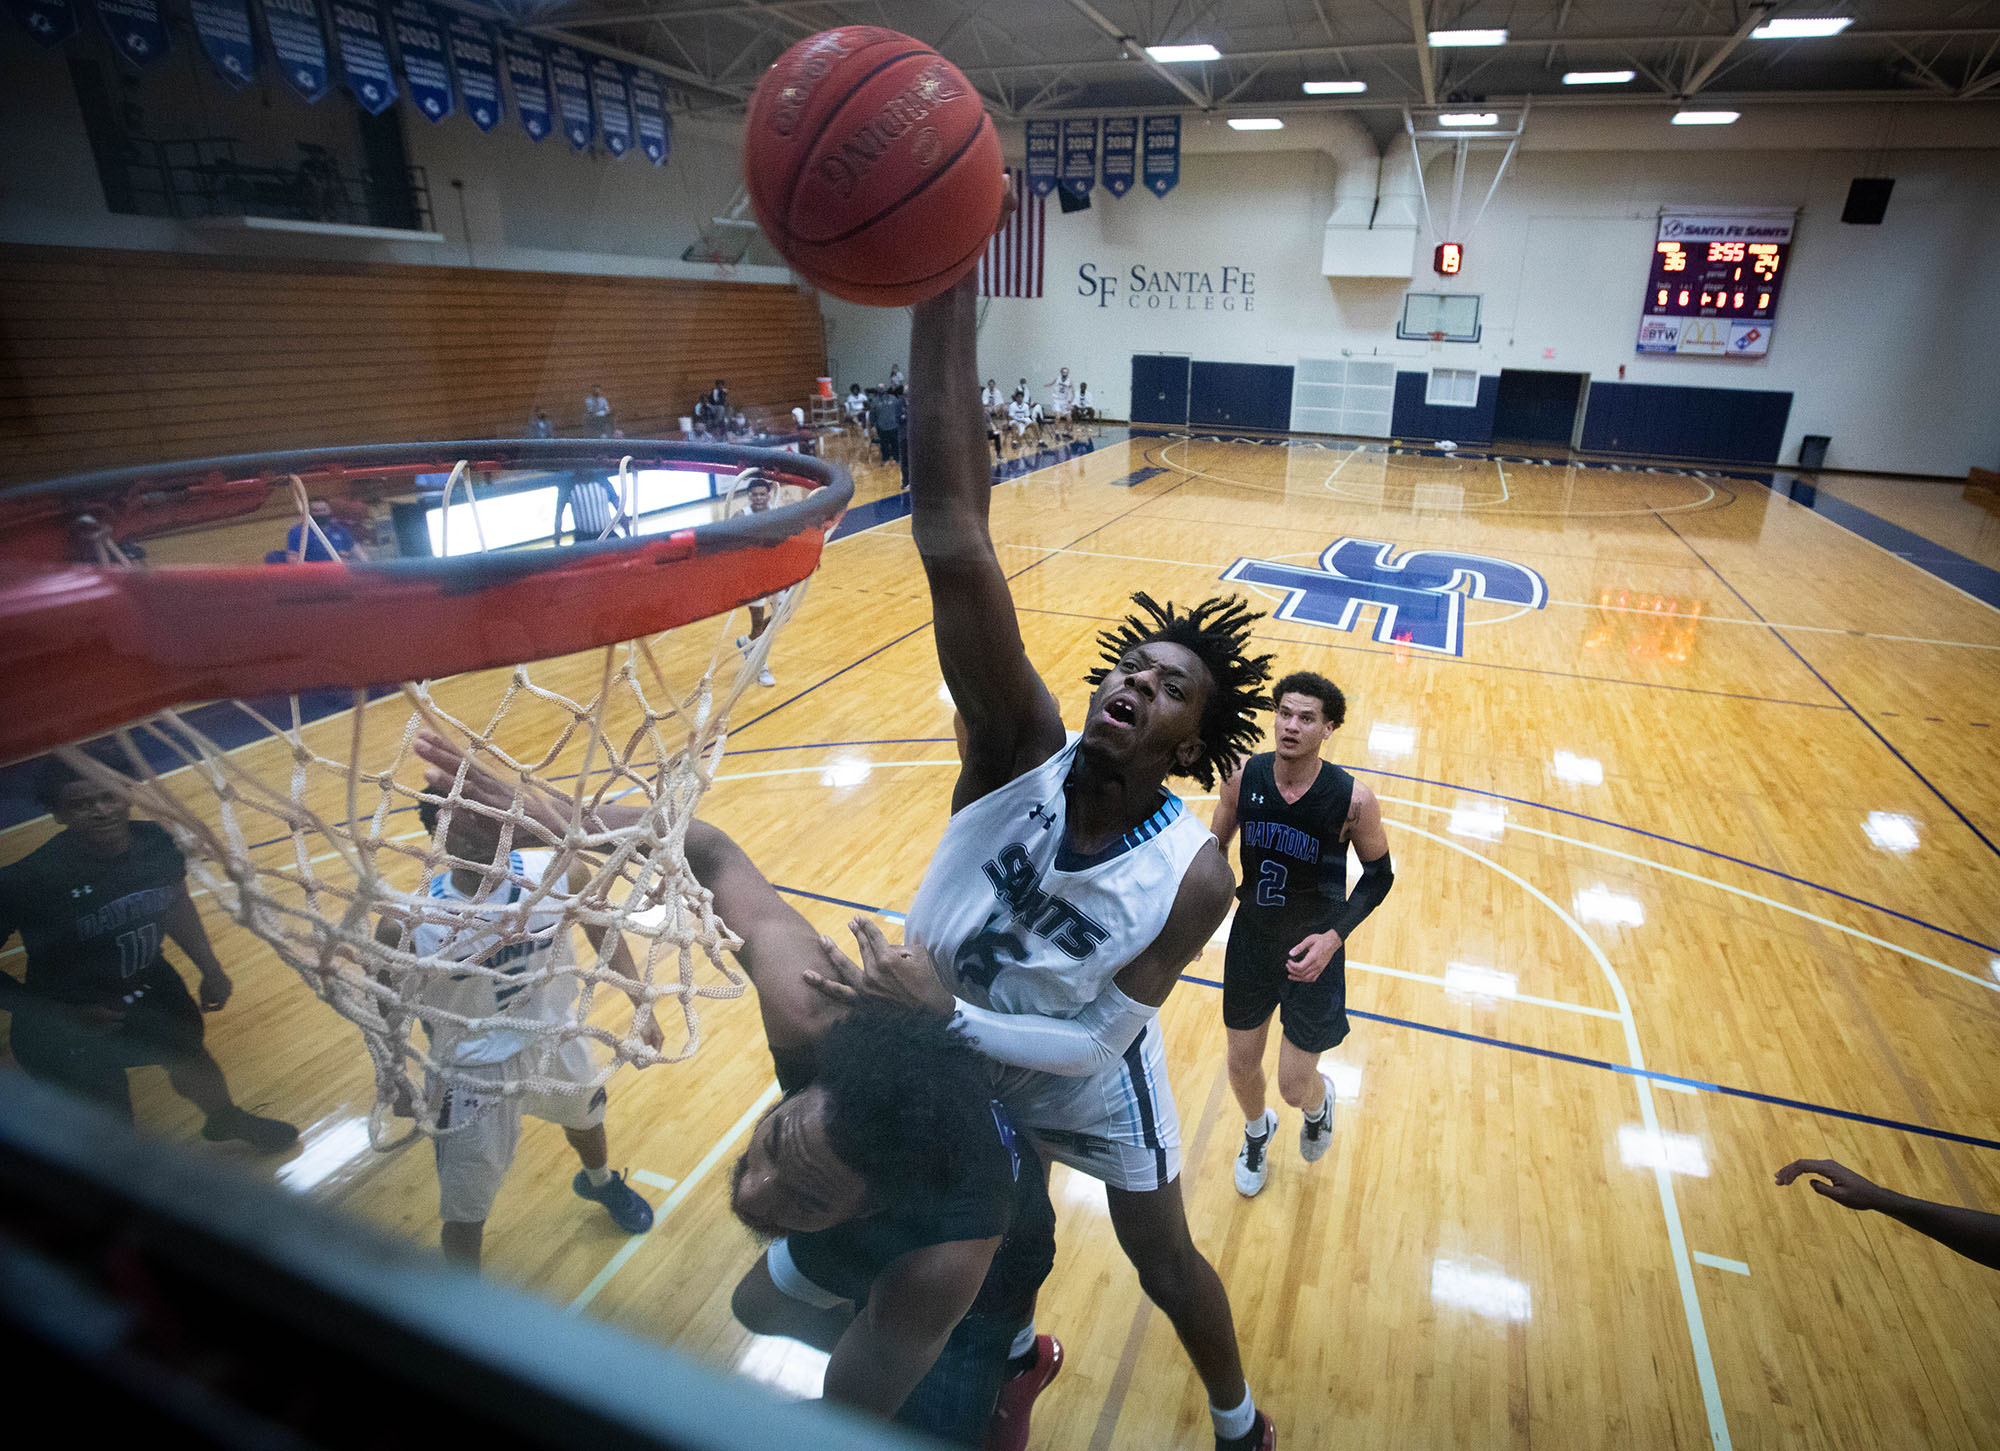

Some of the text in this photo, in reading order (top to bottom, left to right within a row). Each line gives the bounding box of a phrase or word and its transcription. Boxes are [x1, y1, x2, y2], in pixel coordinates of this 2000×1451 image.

[1684, 225, 1790, 237] SANTA FE SAINTS
[1663, 251, 1687, 271] 36
[1707, 242, 1746, 262] 3:55
[1754, 254, 1780, 273] 24
[1128, 294, 1256, 312] COLLEGE
[1244, 820, 1320, 864] DAYTONA
[1256, 859, 1289, 907] 2
